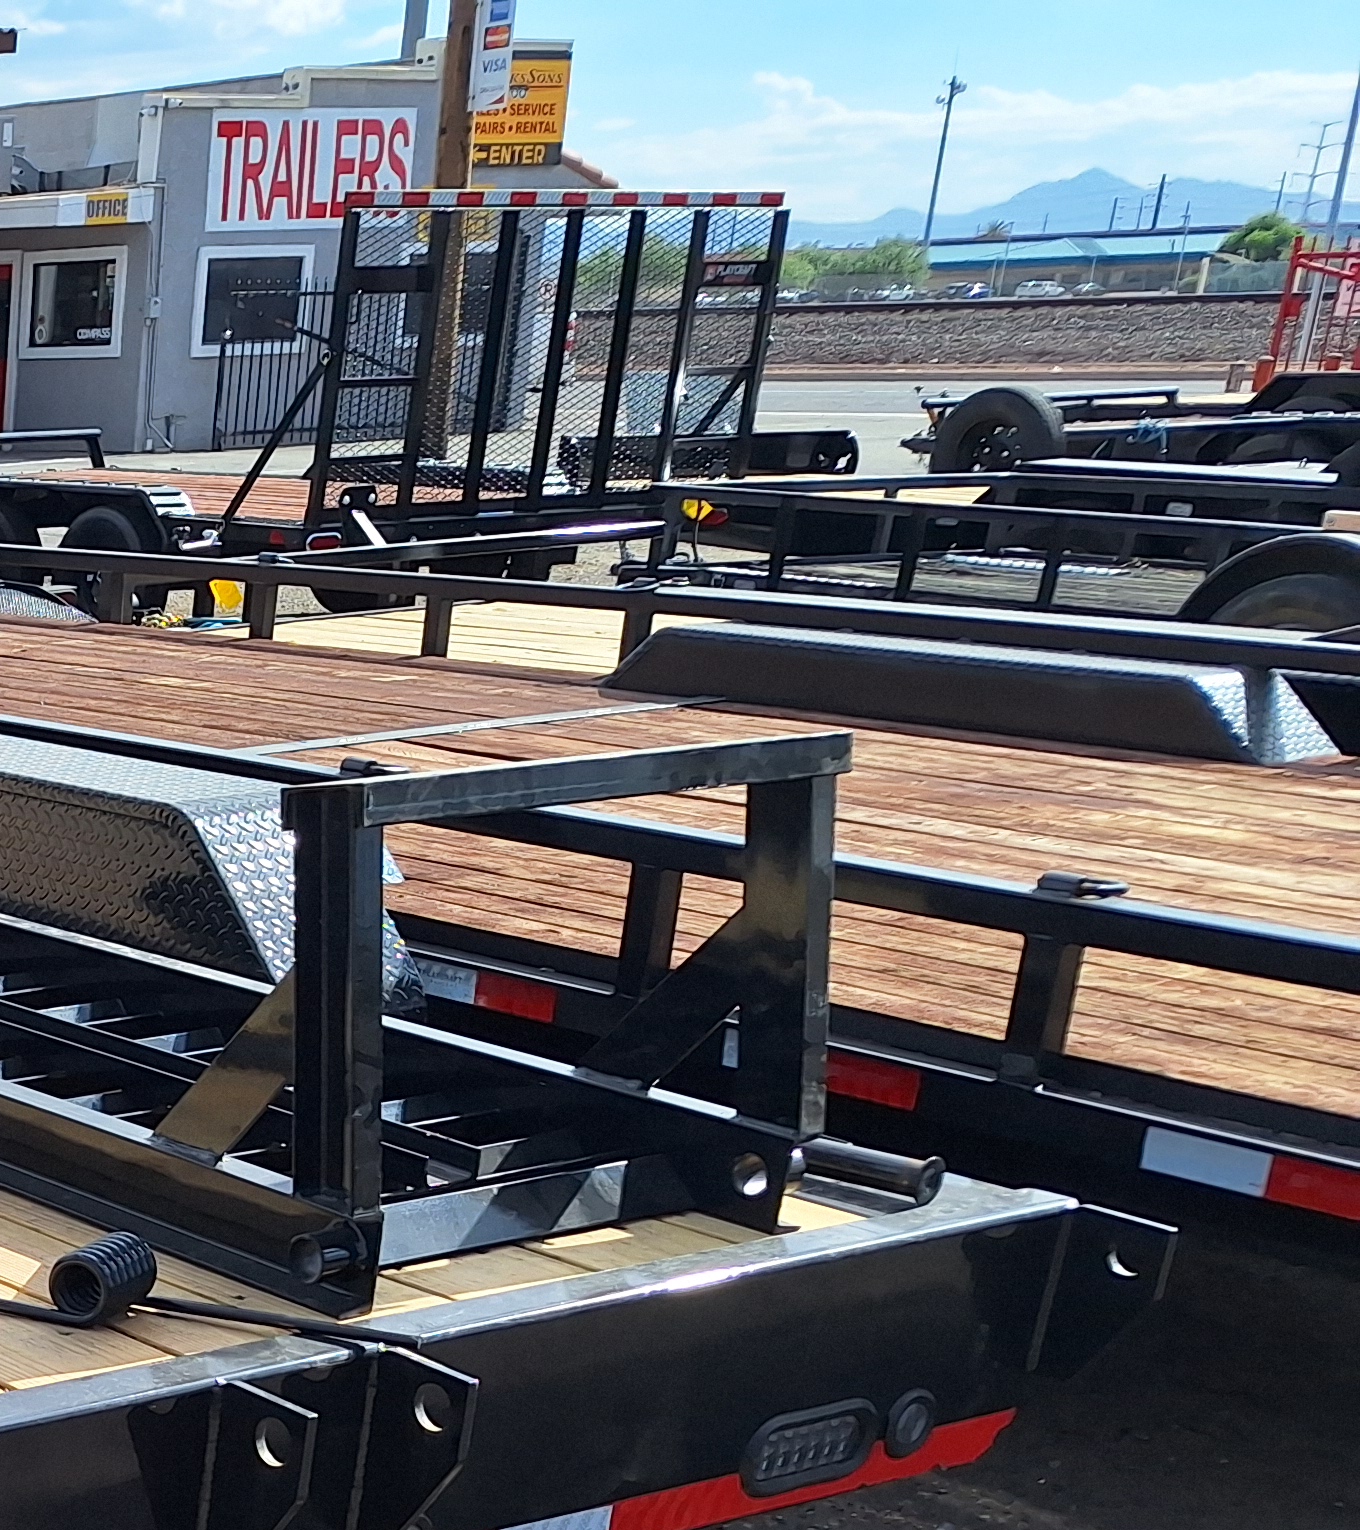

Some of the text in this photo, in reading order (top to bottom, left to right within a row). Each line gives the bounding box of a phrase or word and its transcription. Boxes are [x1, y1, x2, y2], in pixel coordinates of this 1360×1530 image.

[482, 58, 507, 74] VISA
[509, 102, 557, 117] SERVICE
[474, 121, 558, 135] PAIRS RENTAL
[488, 144, 546, 165] ENTER
[216, 116, 411, 222] TRAILERS
[86, 199, 128, 218] OFFICE
